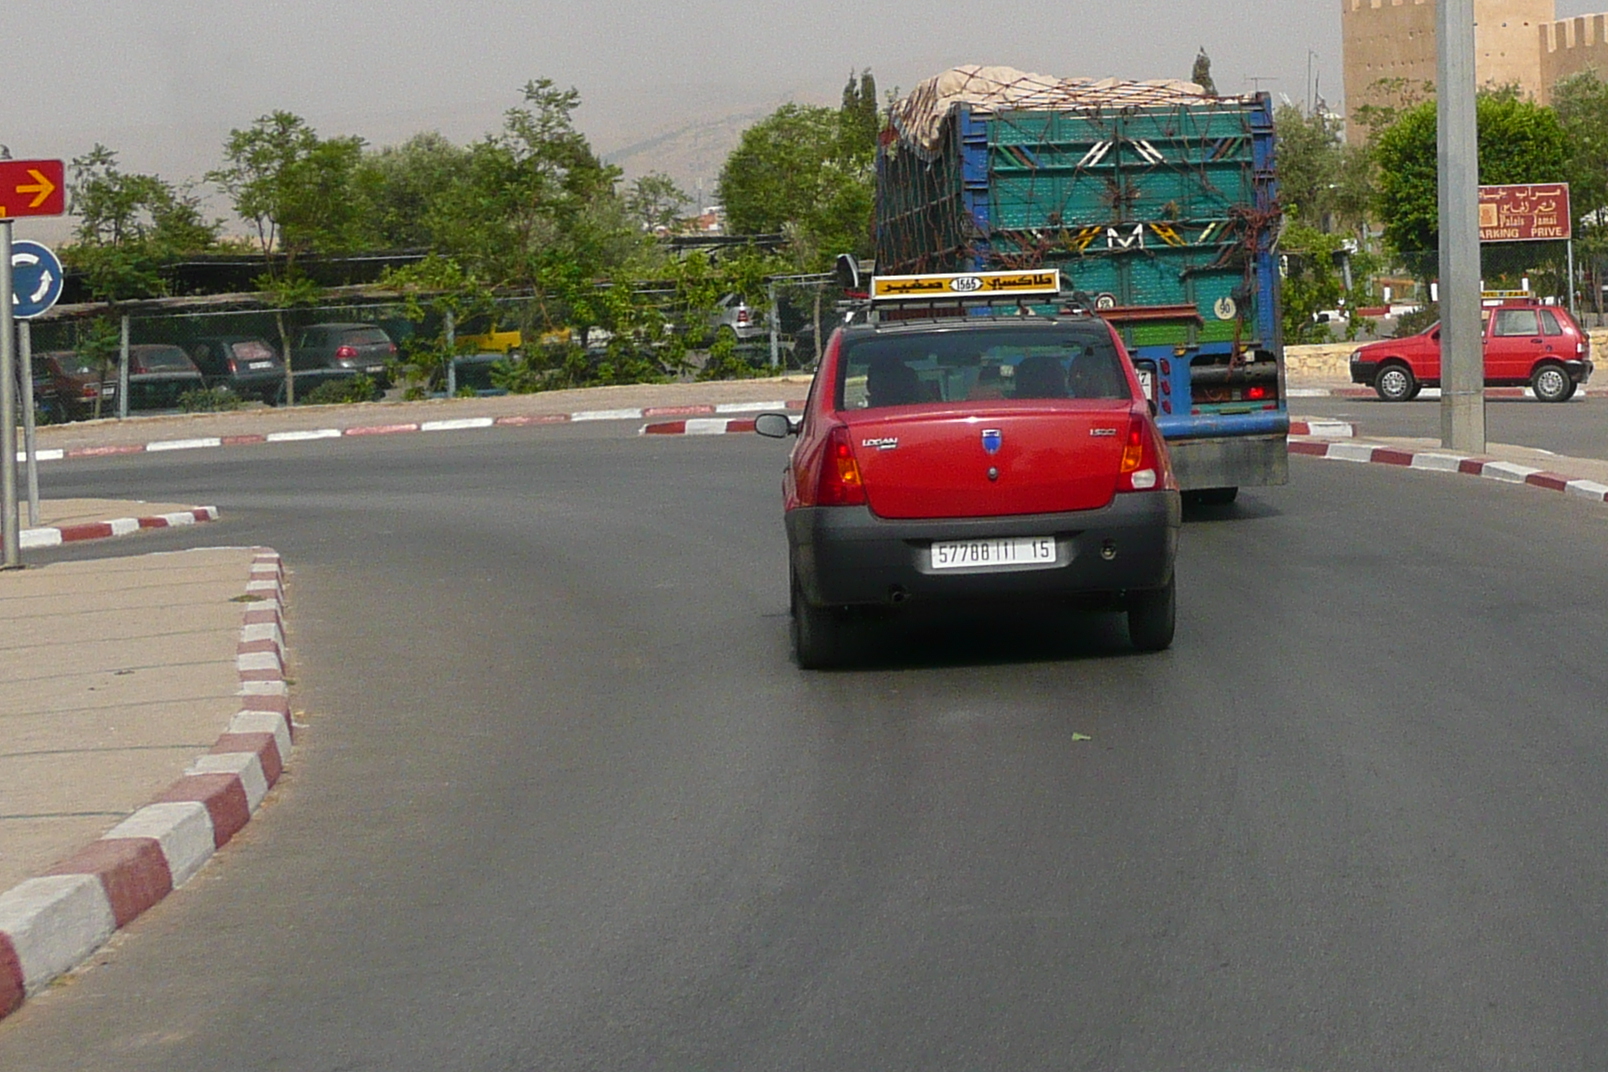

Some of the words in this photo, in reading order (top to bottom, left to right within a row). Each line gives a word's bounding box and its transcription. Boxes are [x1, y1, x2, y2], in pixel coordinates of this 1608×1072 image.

[1499, 213, 1525, 228] Palais
[1479, 227, 1519, 239] ARKING
[1531, 226, 1562, 238] PRIVE
[956, 277, 976, 291] 1565
[939, 543, 990, 563] 57788
[1032, 540, 1050, 558] 15
